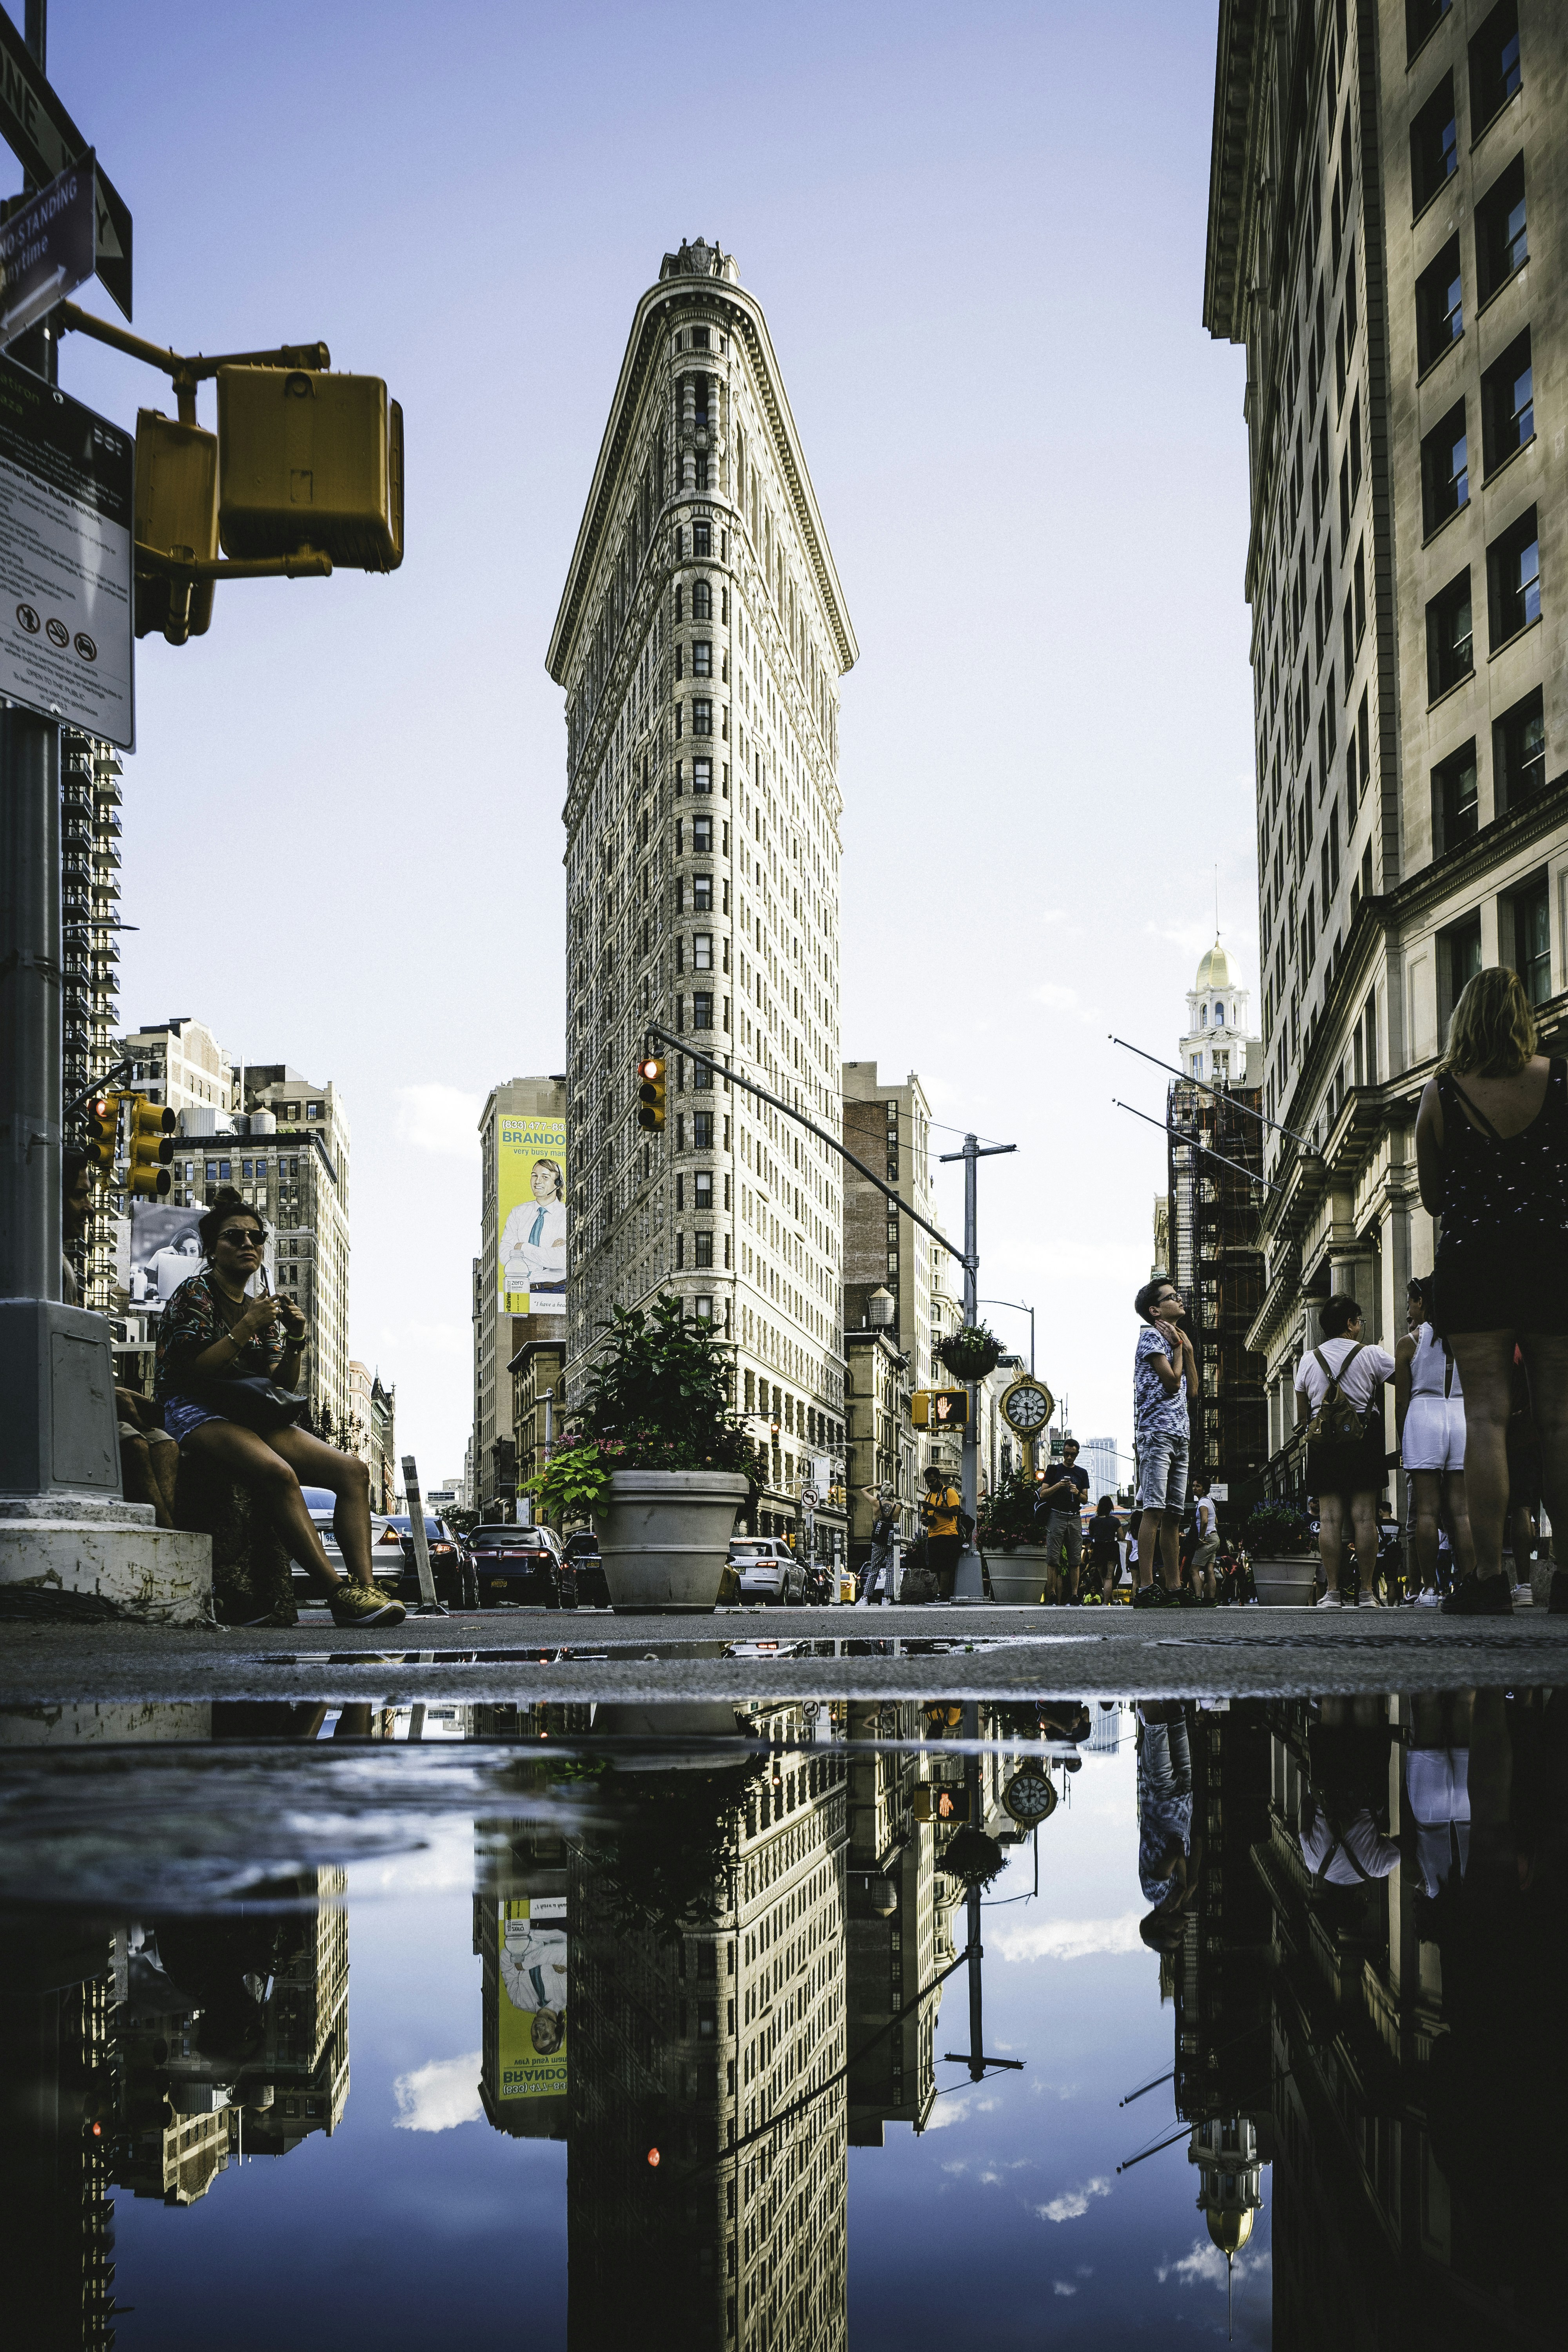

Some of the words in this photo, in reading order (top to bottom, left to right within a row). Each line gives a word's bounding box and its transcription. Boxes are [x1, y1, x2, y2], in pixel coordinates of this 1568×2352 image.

[0, 46, 40, 142] NE
[16, 176, 77, 247] STANDING
[26, 472, 47, 494] Plaza
[49, 486, 69, 507] Rules
[13, 629, 33, 646] Permits
[81, 663, 98, 678] events
[26, 667, 43, 682] OPEN
[44, 675, 52, 686] TO
[53, 679, 64, 691] THE
[64, 685, 85, 701] PUBLIC
[502, 1120, 526, 1131] (833)
[528, 1122, 566, 1131] 477-83
[503, 1131, 566, 1145] BRANDO
